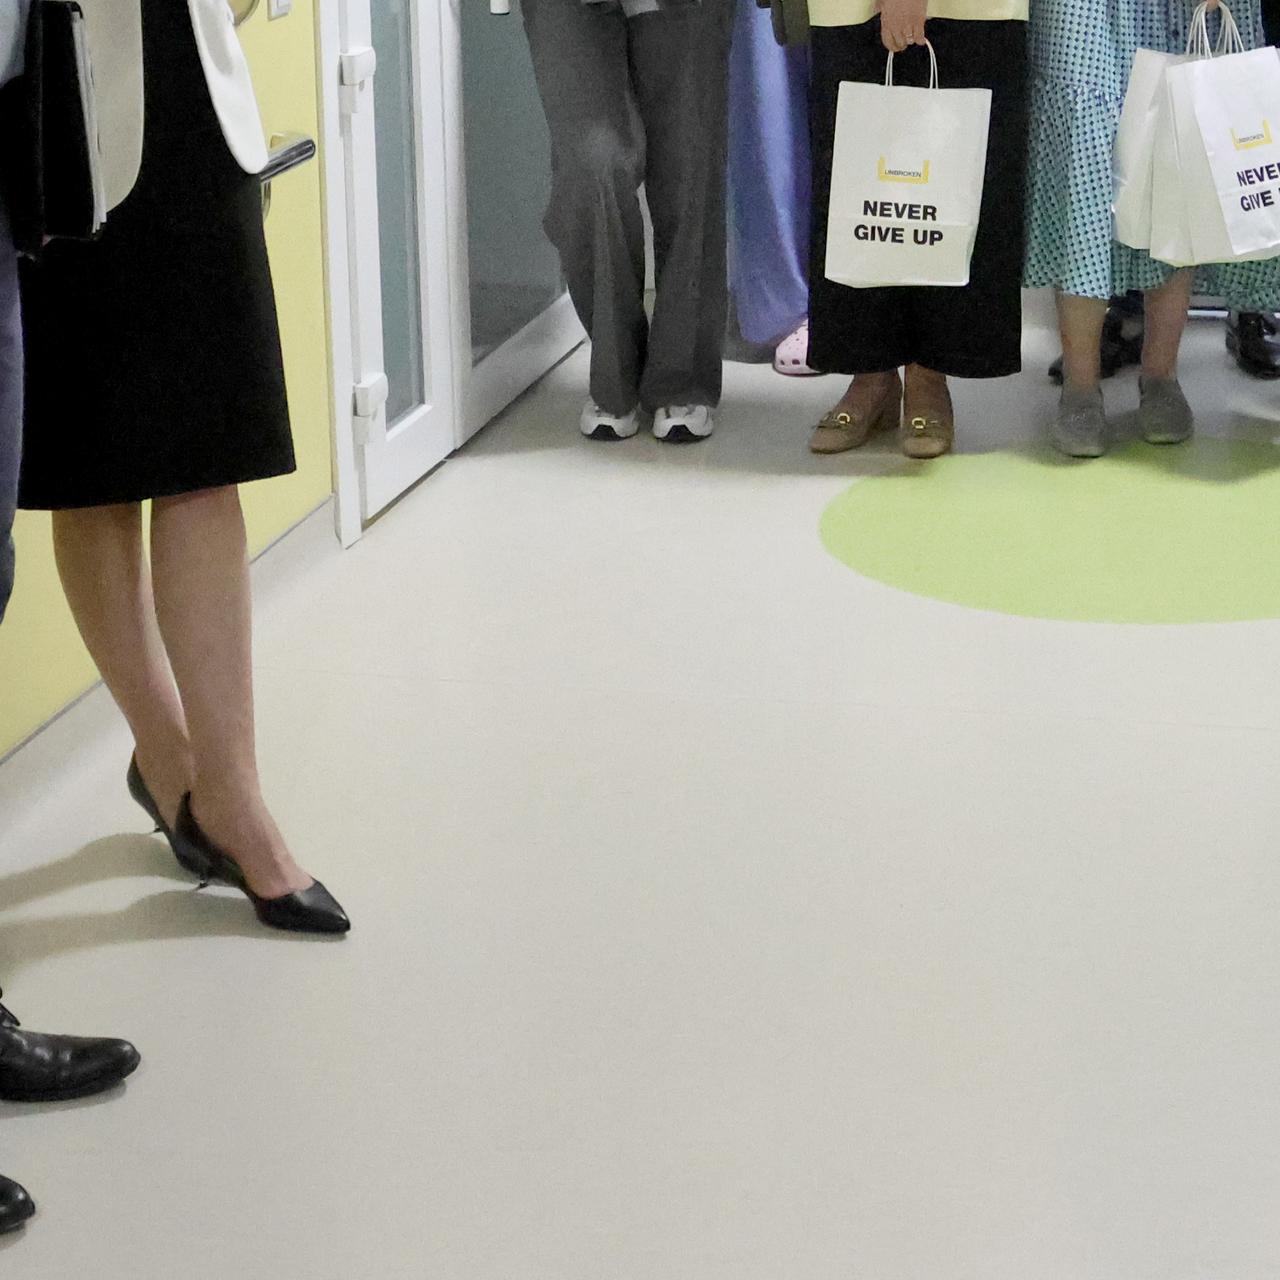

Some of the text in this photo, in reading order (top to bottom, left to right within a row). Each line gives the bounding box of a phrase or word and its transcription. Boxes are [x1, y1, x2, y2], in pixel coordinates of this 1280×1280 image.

[884, 169, 922, 179] UNBROKEN
[863, 200, 938, 221] NEVER
[1240, 190, 1274, 212] GIVE
[854, 224, 944, 246] GIVE UP
